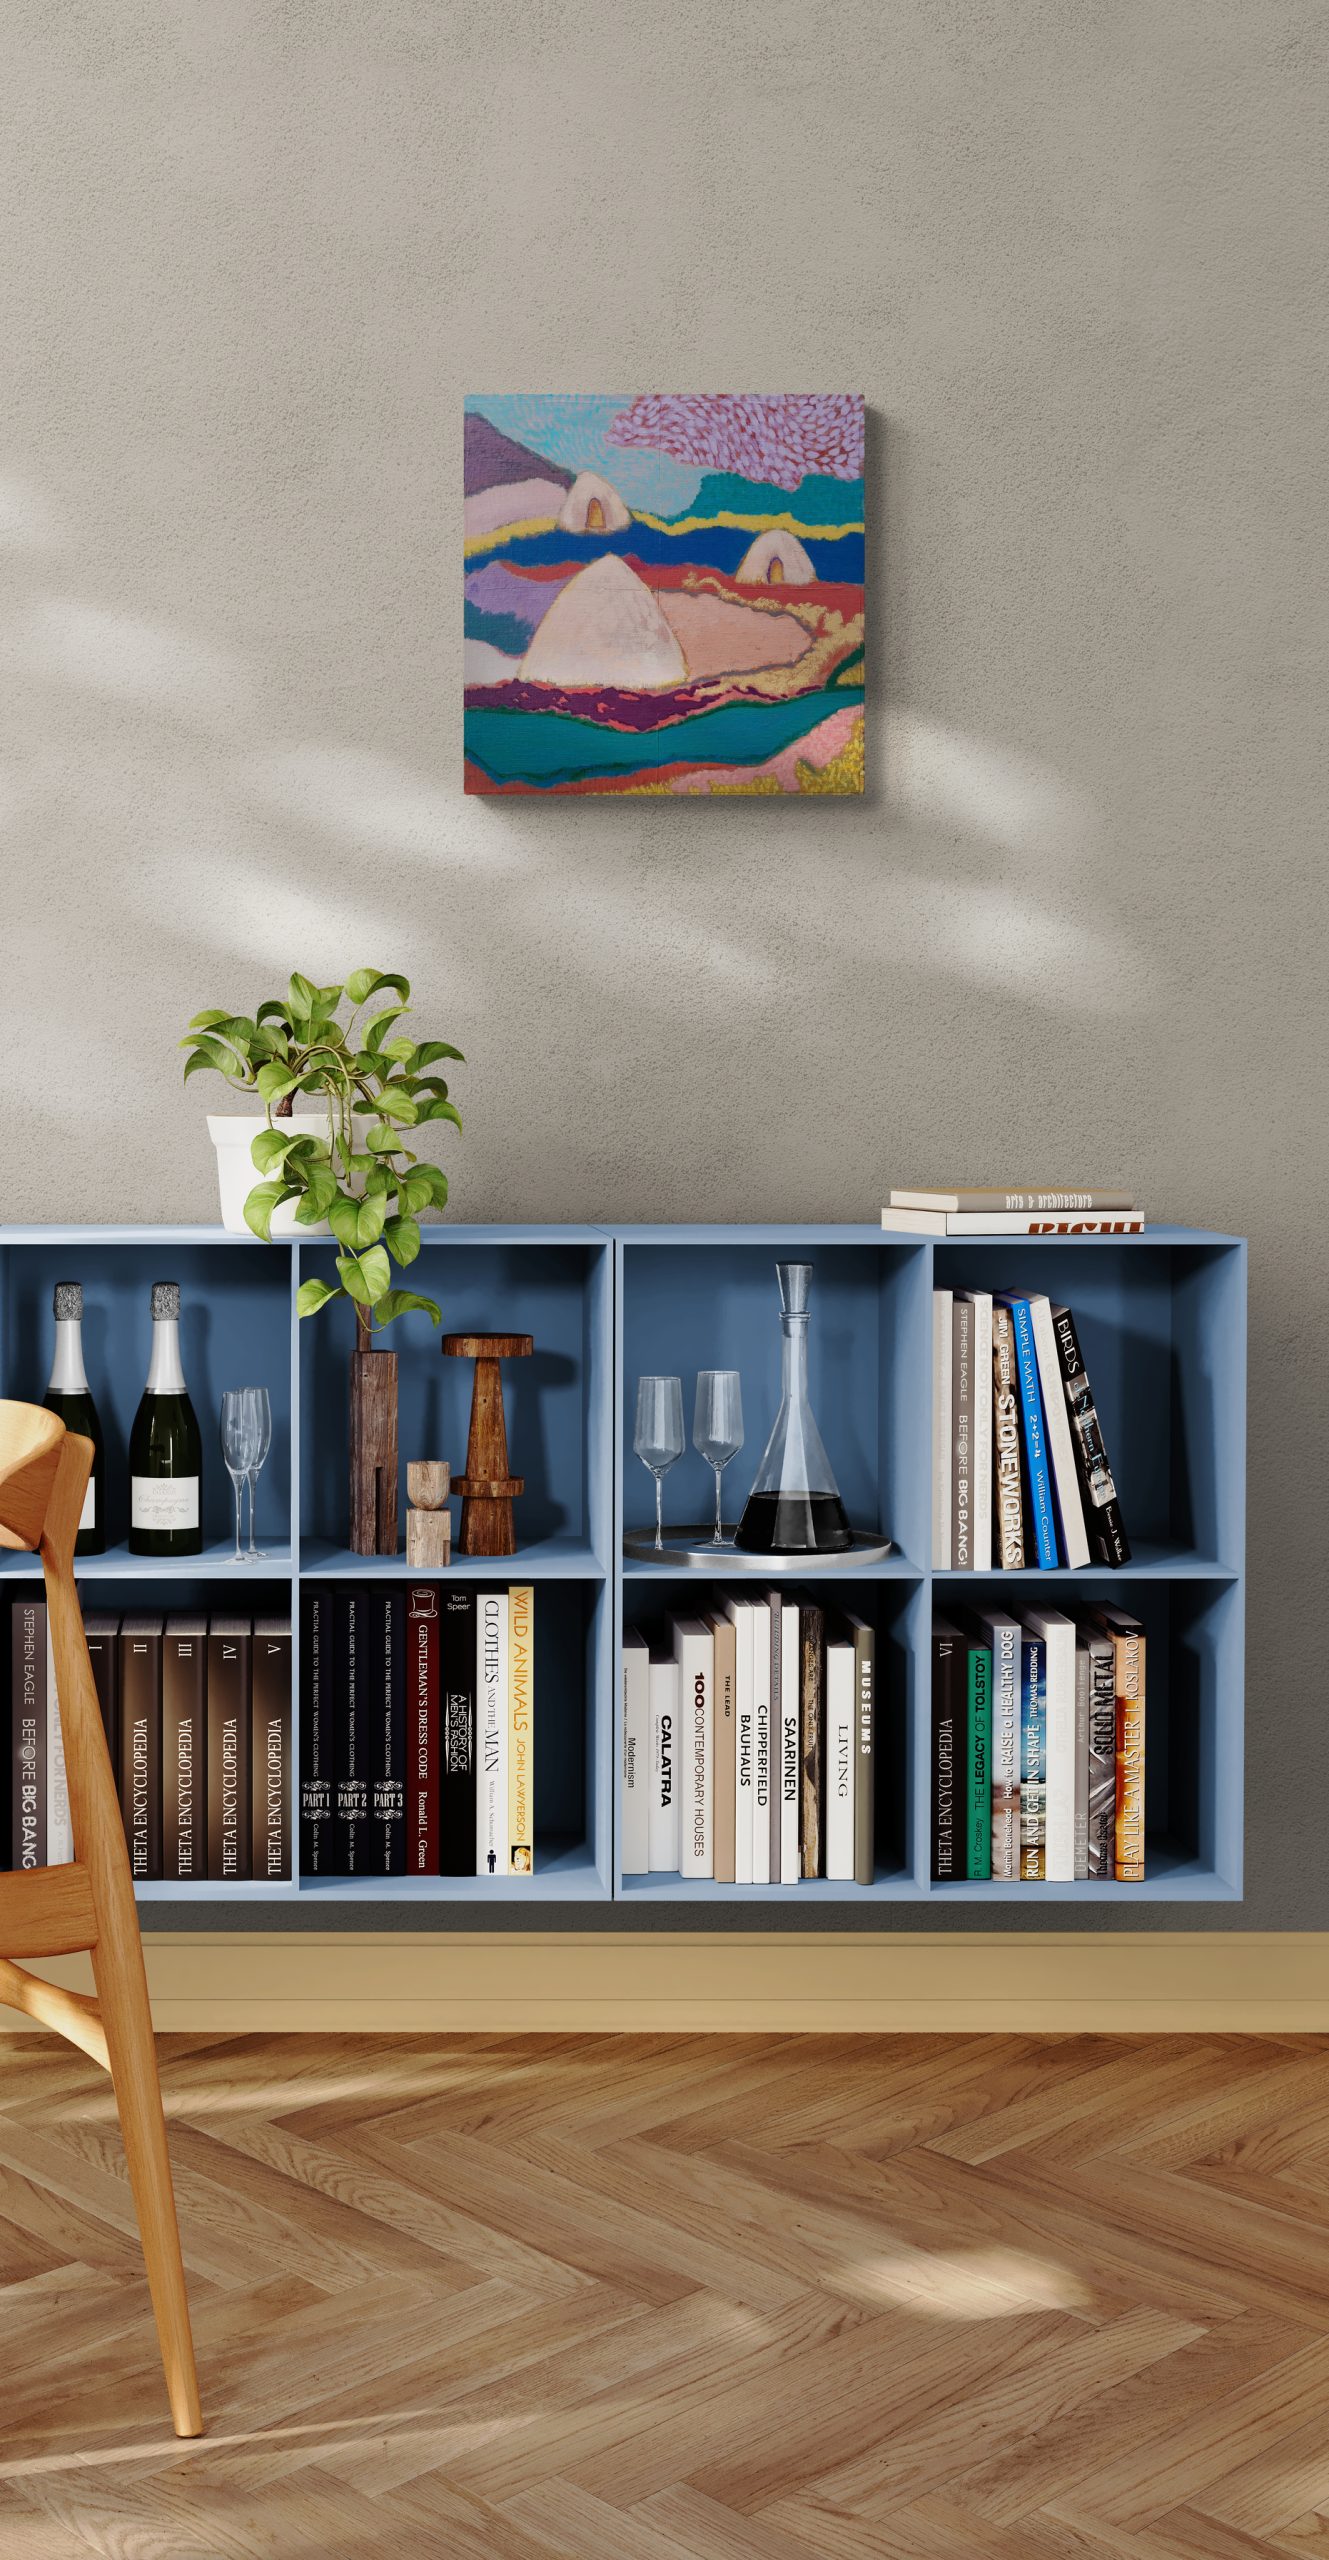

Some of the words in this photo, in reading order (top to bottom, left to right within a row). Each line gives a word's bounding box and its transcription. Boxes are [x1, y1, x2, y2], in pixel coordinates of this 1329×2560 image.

[1006, 1193, 1024, 1209] arts
[1038, 1192, 1092, 1209] architecture
[960, 1308, 968, 1358] STEPHEN
[998, 1316, 1009, 1338] JIM
[1017, 1308, 1031, 1358] SIMPLE
[1057, 1318, 1080, 1374] BIRDS
[960, 1362, 968, 1402] EAGLE
[979, 1358, 989, 1391] NOT
[999, 1343, 1011, 1385] GREEN
[1023, 1361, 1036, 1403] MATH
[979, 1394, 989, 1438] ONLY
[958, 1414, 968, 1476] BEFORE
[979, 1440, 989, 1472] FOR
[958, 1479, 968, 1507] BIG
[979, 1474, 989, 1520] NERDS
[998, 1393, 1022, 1564] STONEWORKS
[1036, 1470, 1049, 1513] William
[958, 1509, 968, 1566] BANG!
[1041, 1516, 1052, 1561] Counter
[24, 1609, 35, 1660] STEPHEN
[513, 1591, 528, 1637] WILD
[133, 1643, 147, 1653] II
[178, 1643, 192, 1657] III
[223, 1644, 237, 1660] IV
[268, 1643, 282, 1654] V
[349, 1657, 355, 1667] TO
[385, 1657, 392, 1667] TO
[484, 1600, 499, 1684] CLOTHES
[938, 1643, 953, 1657] VI
[1000, 1631, 1014, 1660] DOG
[24, 1663, 35, 1705] EAGLE
[418, 1624, 428, 1706] GENTLEMAN'S
[975, 1655, 985, 1713] TOLSTOY
[1030, 1647, 1038, 1682] REDDING
[1093, 1651, 1114, 1706] METAL
[1125, 1630, 1139, 1700] KOSLAKOV
[459, 1694, 467, 1703] A
[487, 1686, 496, 1707] AND
[513, 1643, 528, 1731] ANIMALS
[861, 1660, 871, 1755] MUSEUMS
[1000, 1663, 1014, 1717] HEALTHY
[1030, 1684, 1038, 1718] THOMAS
[418, 1709, 428, 1744] DRESS
[450, 1694, 459, 1727] MEN'S
[459, 1705, 467, 1752] HISTORY
[487, 1708, 496, 1728] THE
[975, 1716, 985, 1732] OF
[1005, 1721, 1013, 1729] a
[22, 1718, 36, 1780] BEFORE
[418, 1747, 428, 1779] CODE
[450, 1730, 459, 1772] FASHION
[459, 1755, 467, 1771] OF
[484, 1729, 499, 1772] MAN
[516, 1738, 526, 1771] JOHN
[627, 1737, 636, 1788] Modernism
[661, 1715, 672, 1807] CALATRA
[740, 1714, 751, 1787] BAUHAUS
[757, 1705, 768, 1806] CHIPPERFIELD
[784, 1717, 796, 1801] SAARINEN
[838, 1725, 848, 1798] LIVING
[975, 1735, 985, 1785] LEGACY
[1000, 1732, 1014, 1766] RAISE
[1027, 1724, 1040, 1766] SHAPE
[1123, 1721, 1139, 1784] MASTER
[133, 1718, 147, 1826] ENCYCLOPEDIA
[178, 1718, 192, 1826] ENCYCLOPEDIA
[223, 1718, 237, 1826] ENCYCLOPEDIA
[268, 1718, 282, 1826] ENCYCLOPEDIA
[938, 1718, 953, 1826] ENCYCLOPEDIA
[1003, 1768, 1013, 1778] to
[1003, 1779, 1013, 1799] How
[1027, 1770, 1040, 1784] IN
[22, 1784, 36, 1813] BIG
[54, 1779, 67, 1827] NERDS
[302, 1793, 324, 1807] PART
[338, 1793, 359, 1807] PART
[361, 1793, 367, 1807] 2
[374, 1793, 396, 1807] PART
[398, 1793, 403, 1807] 3
[418, 1791, 428, 1825] Ronald
[516, 1774, 526, 1842] LAWYERSON
[975, 1788, 985, 1810] THE
[1027, 1788, 1040, 1813] GET
[1123, 1788, 1139, 1800] A
[418, 1827, 428, 1837] L.
[694, 1809, 705, 1857] HOUSES
[974, 1818, 984, 1852] Croskey
[1027, 1818, 1040, 1846] AND
[1123, 1805, 1139, 1835] LIKE
[133, 1829, 147, 1875] THETA
[178, 1829, 192, 1875] THETA
[223, 1829, 237, 1875] THETA
[268, 1829, 282, 1875] THETA
[384, 1850, 392, 1870] Spence
[418, 1840, 428, 1869] Green
[938, 1829, 953, 1875] THETA
[974, 1854, 983, 1866] M.
[1027, 1849, 1040, 1877] RUN
[1075, 1812, 1087, 1872] DEMETER
[1123, 1839, 1139, 1877] PLAY
[974, 1868, 983, 1877] R.
[1003, 1850, 1013, 1877] Martin
